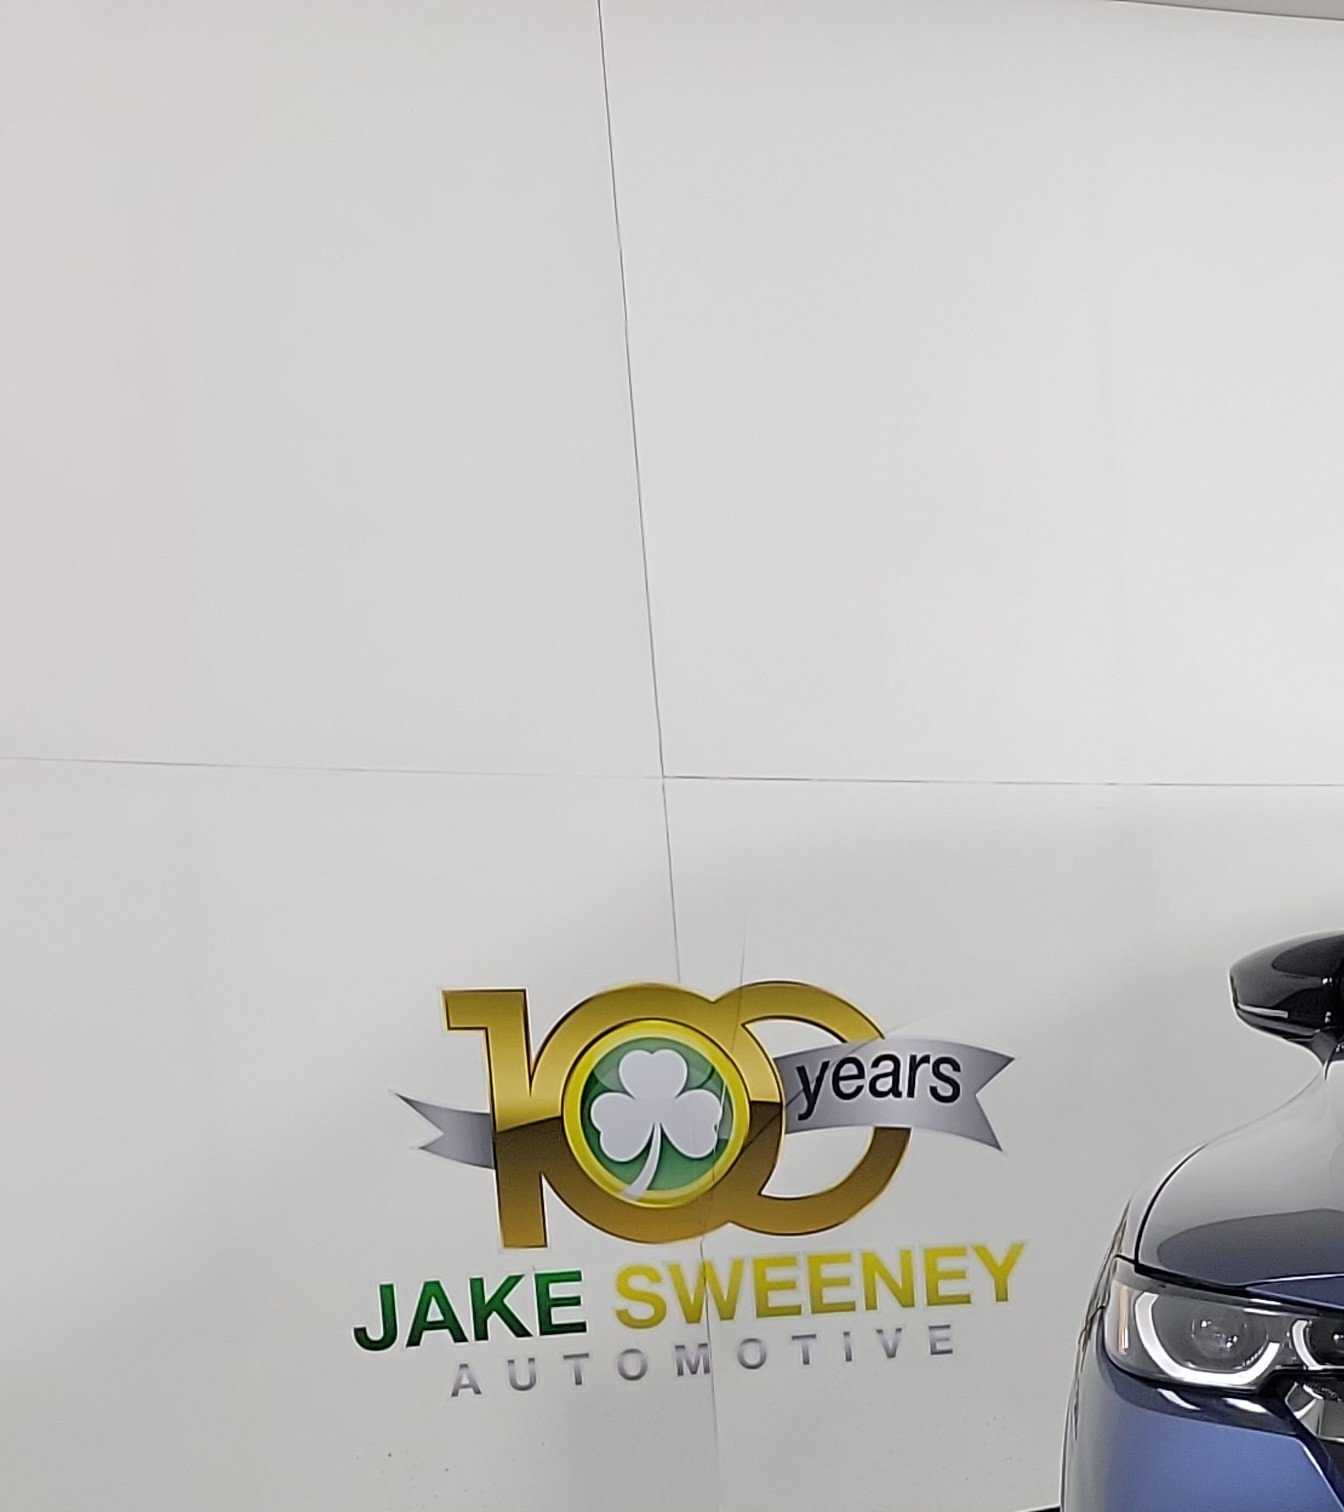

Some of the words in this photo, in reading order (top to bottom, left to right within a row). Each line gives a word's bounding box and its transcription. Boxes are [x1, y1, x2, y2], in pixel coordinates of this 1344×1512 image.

[440, 980, 912, 1249] 100
[797, 1052, 963, 1121] years
[352, 1270, 587, 1352] JAKE
[614, 1243, 1026, 1330] SWEENEY
[450, 1325, 954, 1398] AUTOMOTIVE
